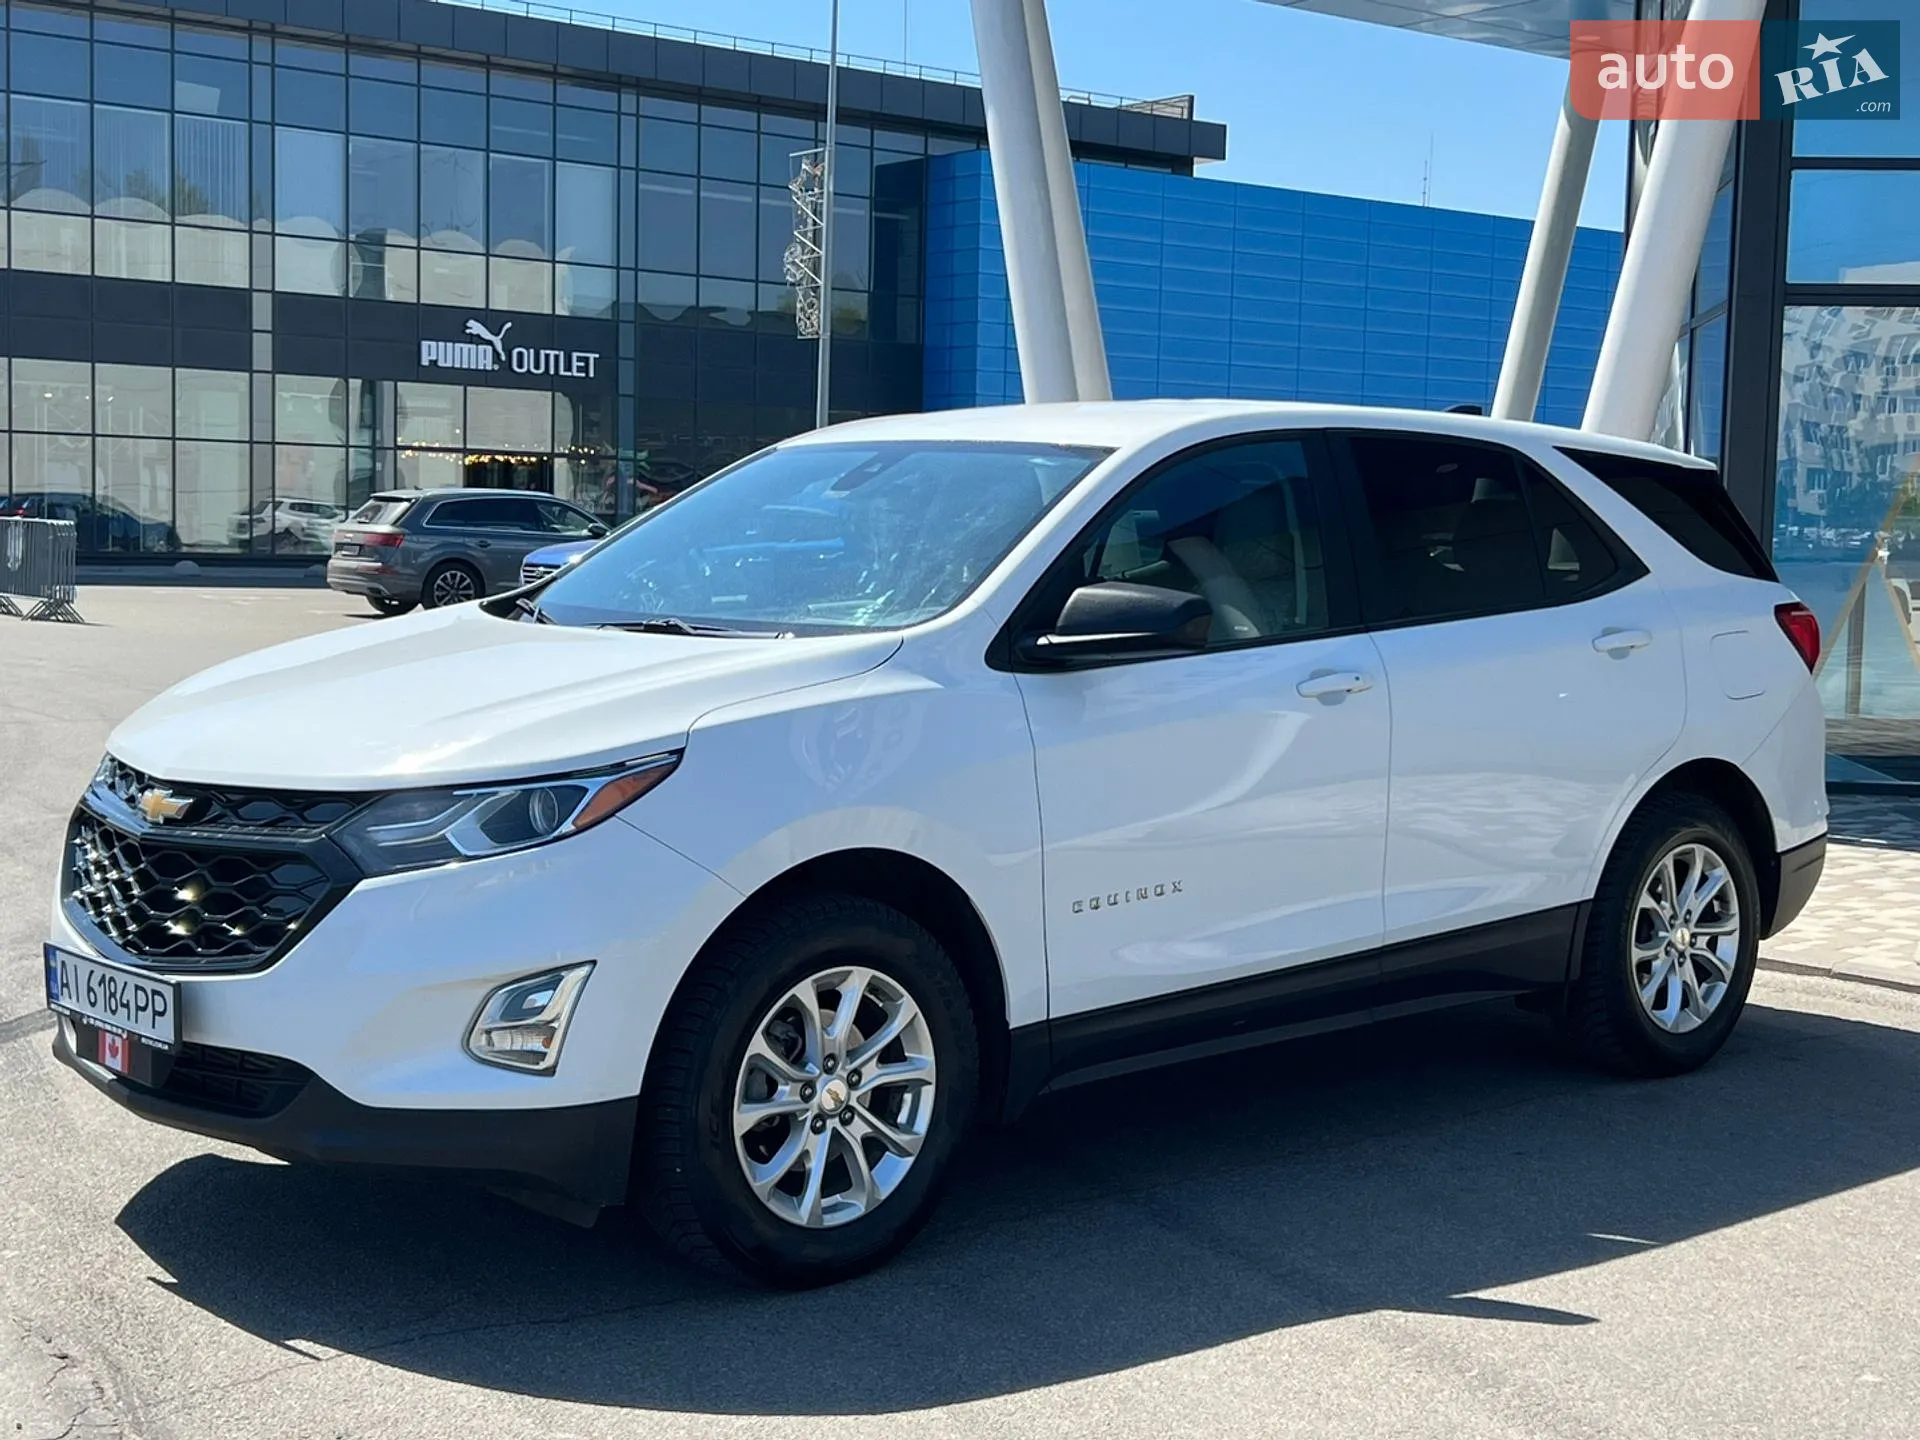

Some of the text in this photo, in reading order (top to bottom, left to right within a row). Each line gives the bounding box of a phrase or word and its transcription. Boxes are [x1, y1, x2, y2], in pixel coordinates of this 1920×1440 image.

[420, 340, 600, 378] PUMA OUTLET
[1072, 880, 1183, 914] EQUINOX
[60, 960, 80, 1003] AI
